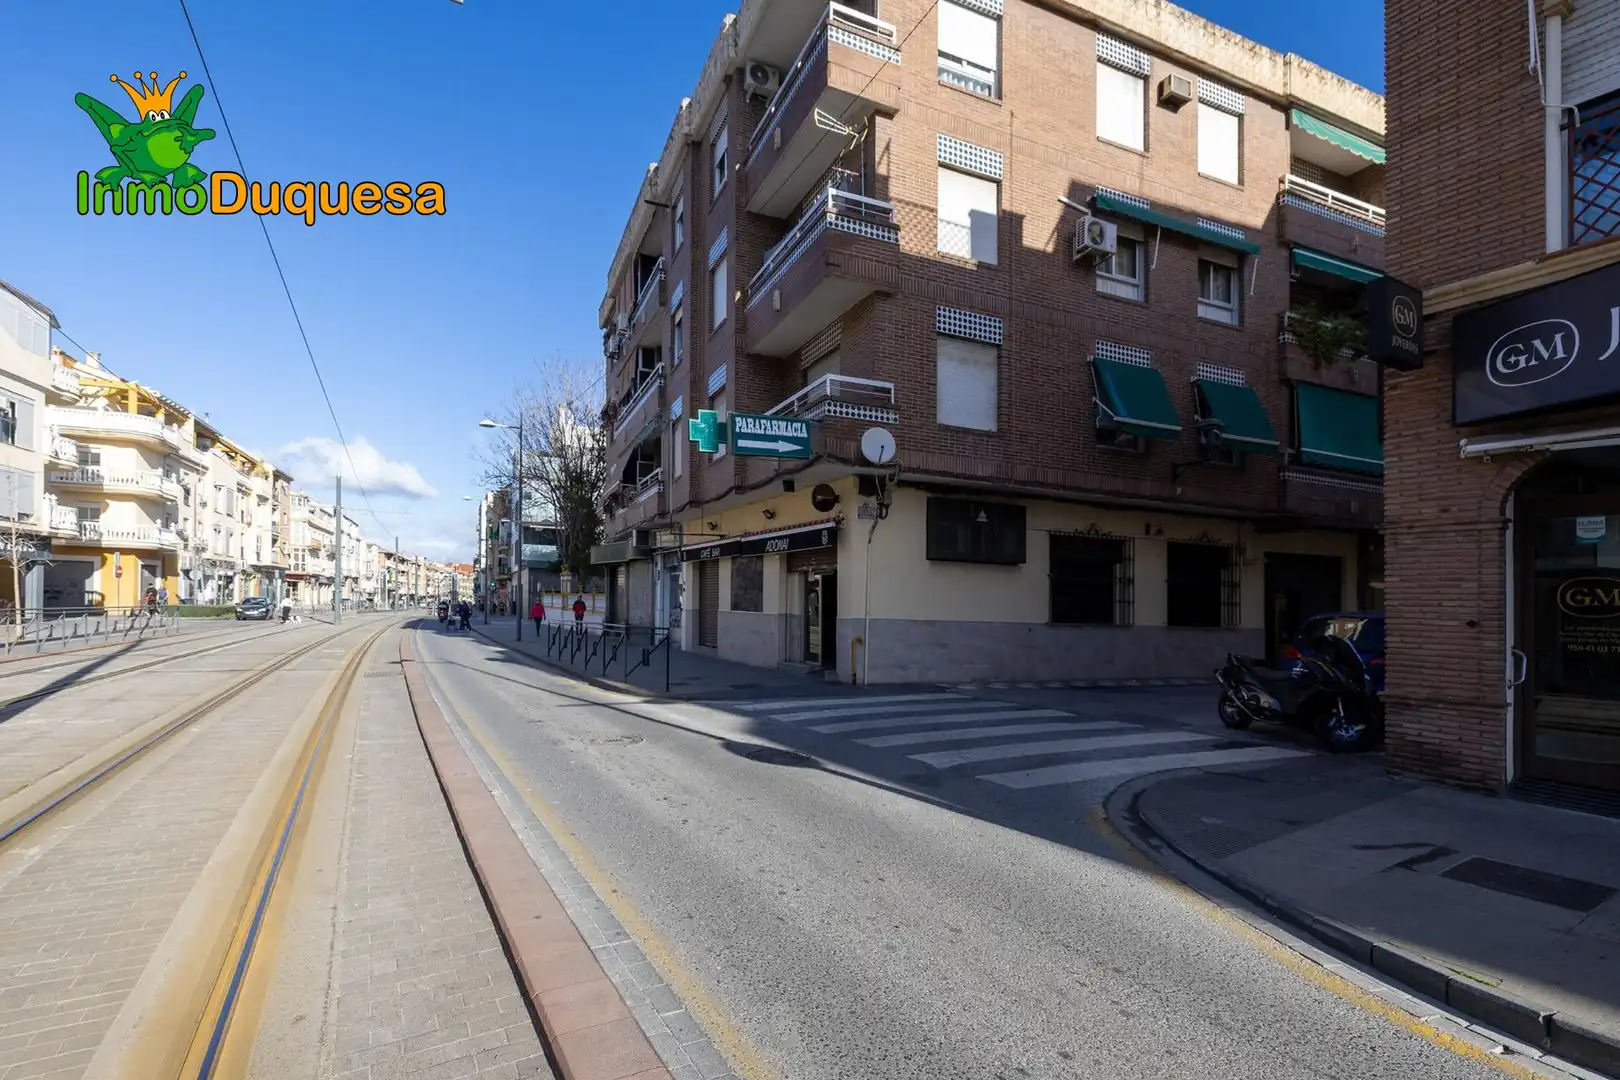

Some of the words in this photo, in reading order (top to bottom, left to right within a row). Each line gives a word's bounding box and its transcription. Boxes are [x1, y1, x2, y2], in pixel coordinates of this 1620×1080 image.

[1395, 304, 1414, 329] GM
[1496, 331, 1568, 374] GM
[735, 416, 808, 438] PARAFARMACIA
[712, 547, 720, 557] BAR
[1565, 587, 1620, 607] GM
